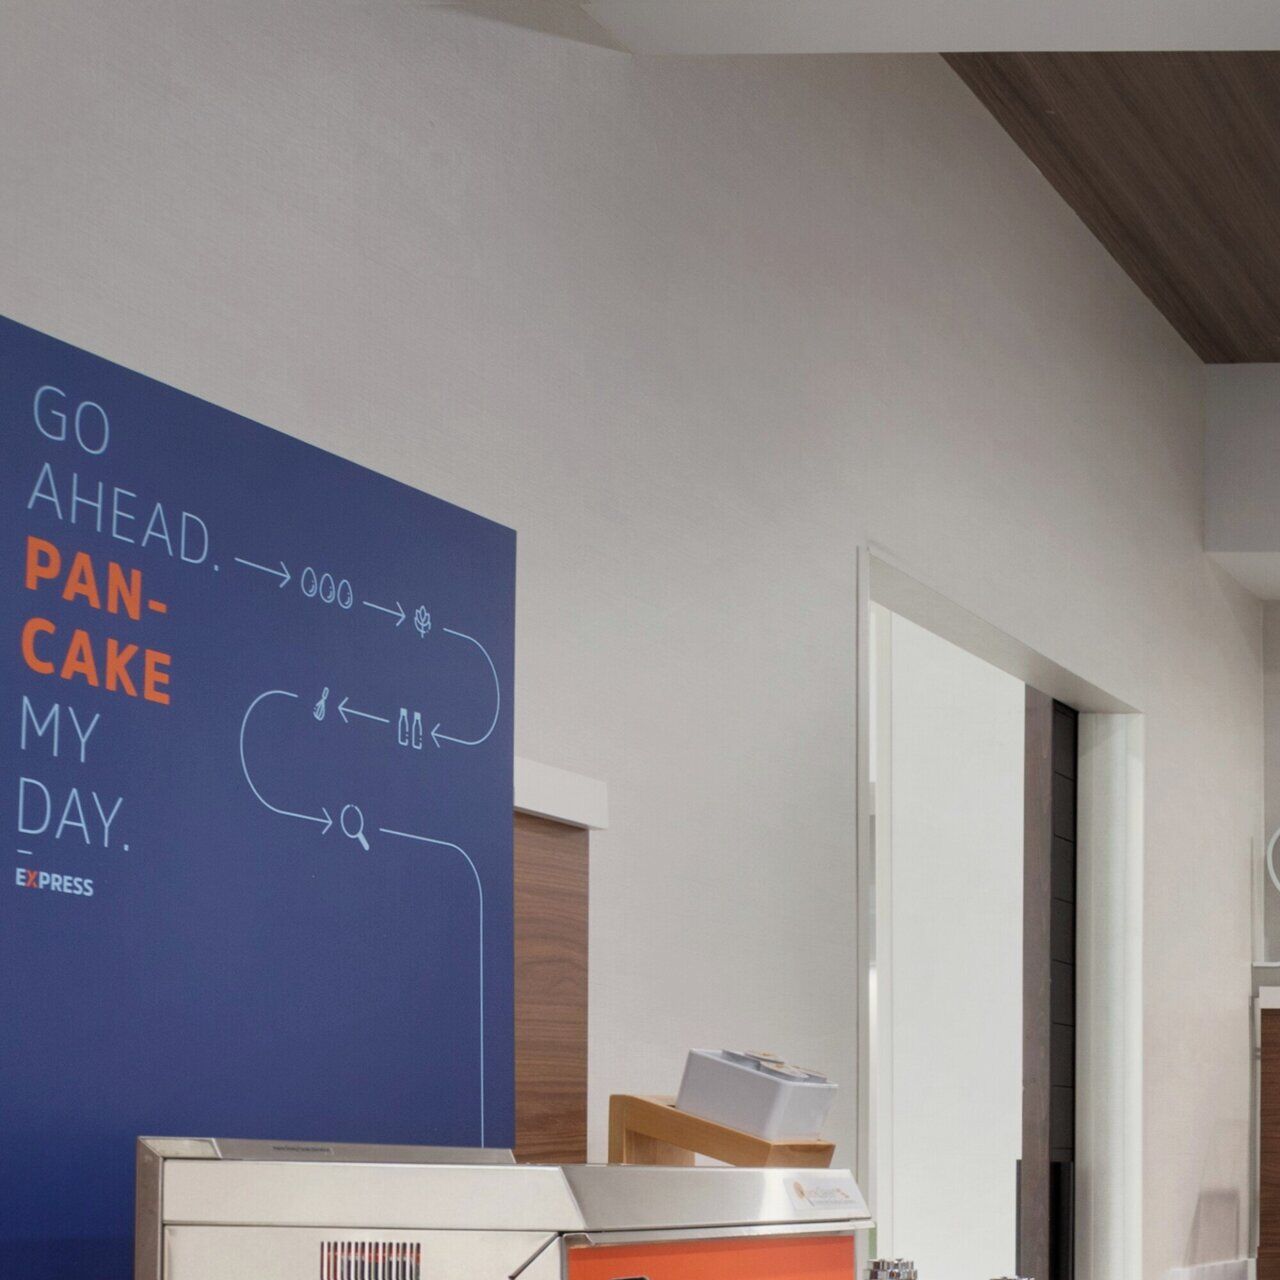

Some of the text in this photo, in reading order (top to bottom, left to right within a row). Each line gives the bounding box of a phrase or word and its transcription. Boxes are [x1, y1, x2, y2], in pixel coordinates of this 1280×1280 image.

[34, 385, 109, 454] GO
[27, 462, 219, 572] AHEAD.
[25, 535, 167, 620] PAN-
[21, 617, 172, 705] CAKE
[21, 695, 100, 763] MY
[18, 777, 129, 851] DAY.
[15, 867, 94, 897] EXPRESS
